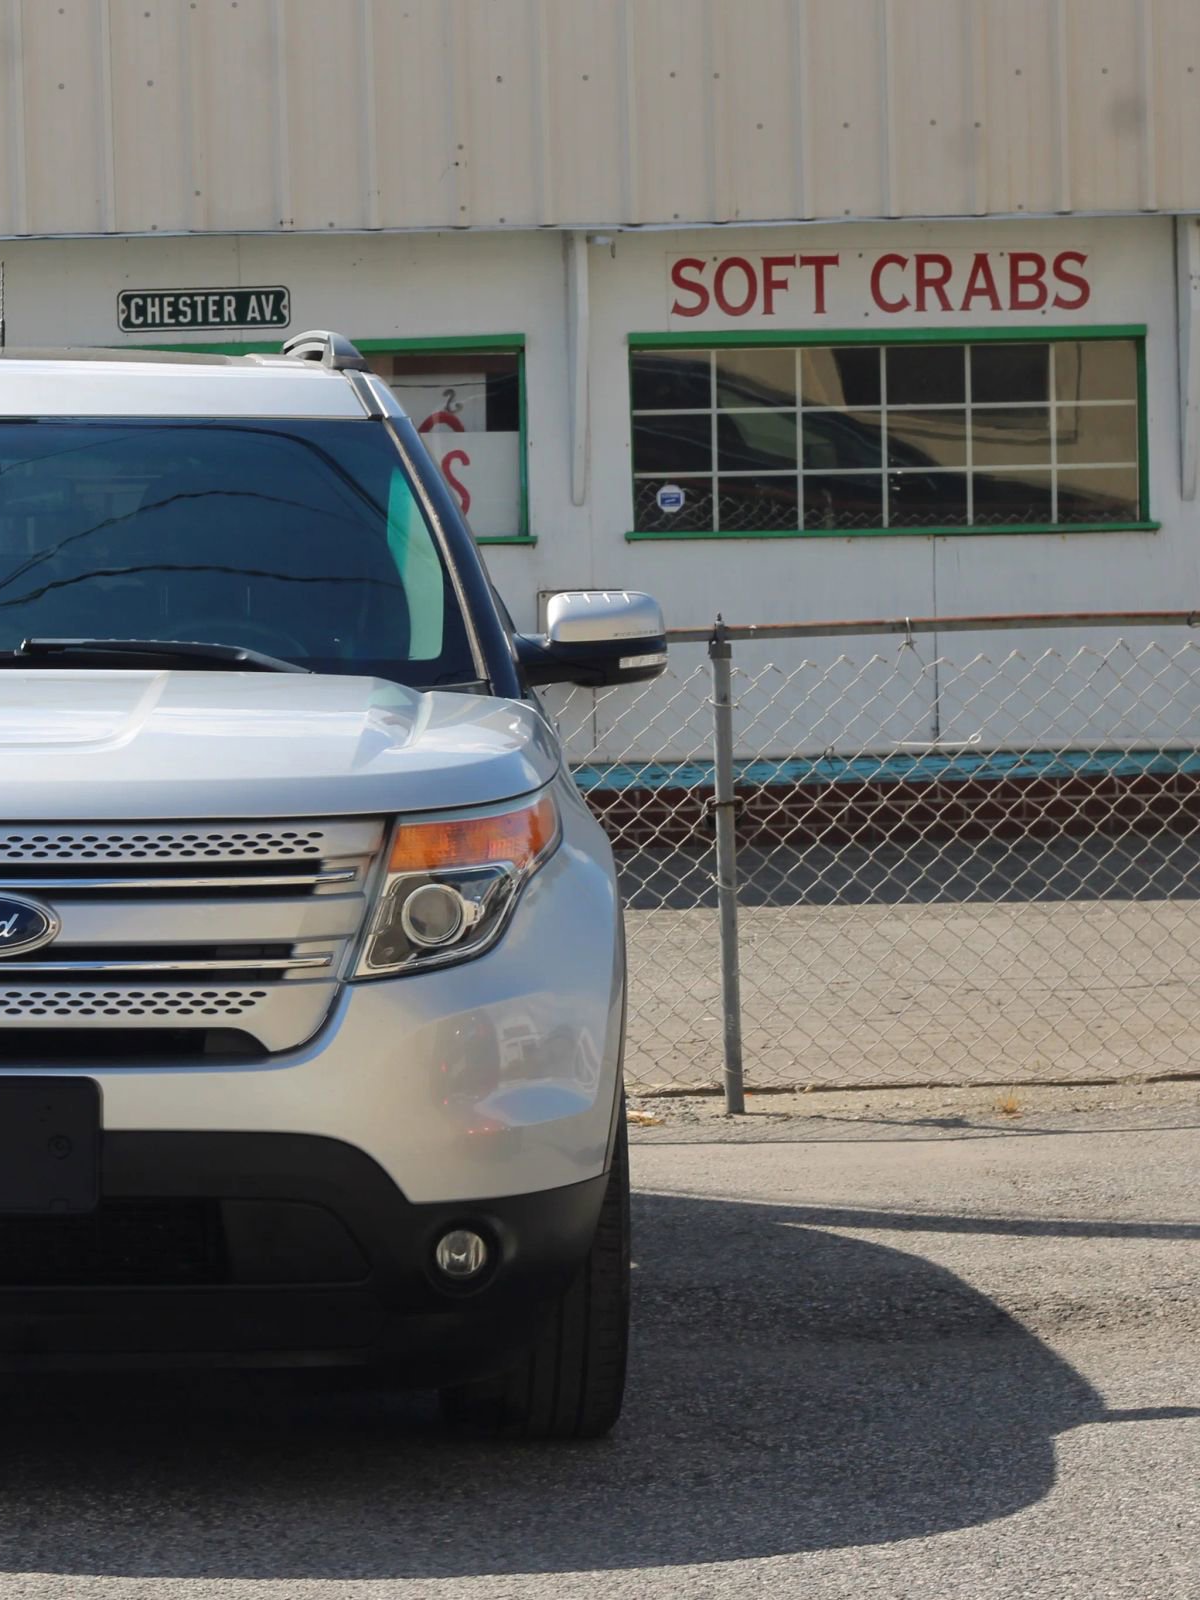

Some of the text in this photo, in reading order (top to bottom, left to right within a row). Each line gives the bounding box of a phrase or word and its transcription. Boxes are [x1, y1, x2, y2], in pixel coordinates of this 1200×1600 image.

[671, 251, 1091, 318] SOFT CRABS
[130, 294, 278, 325] CHESTER AV.
